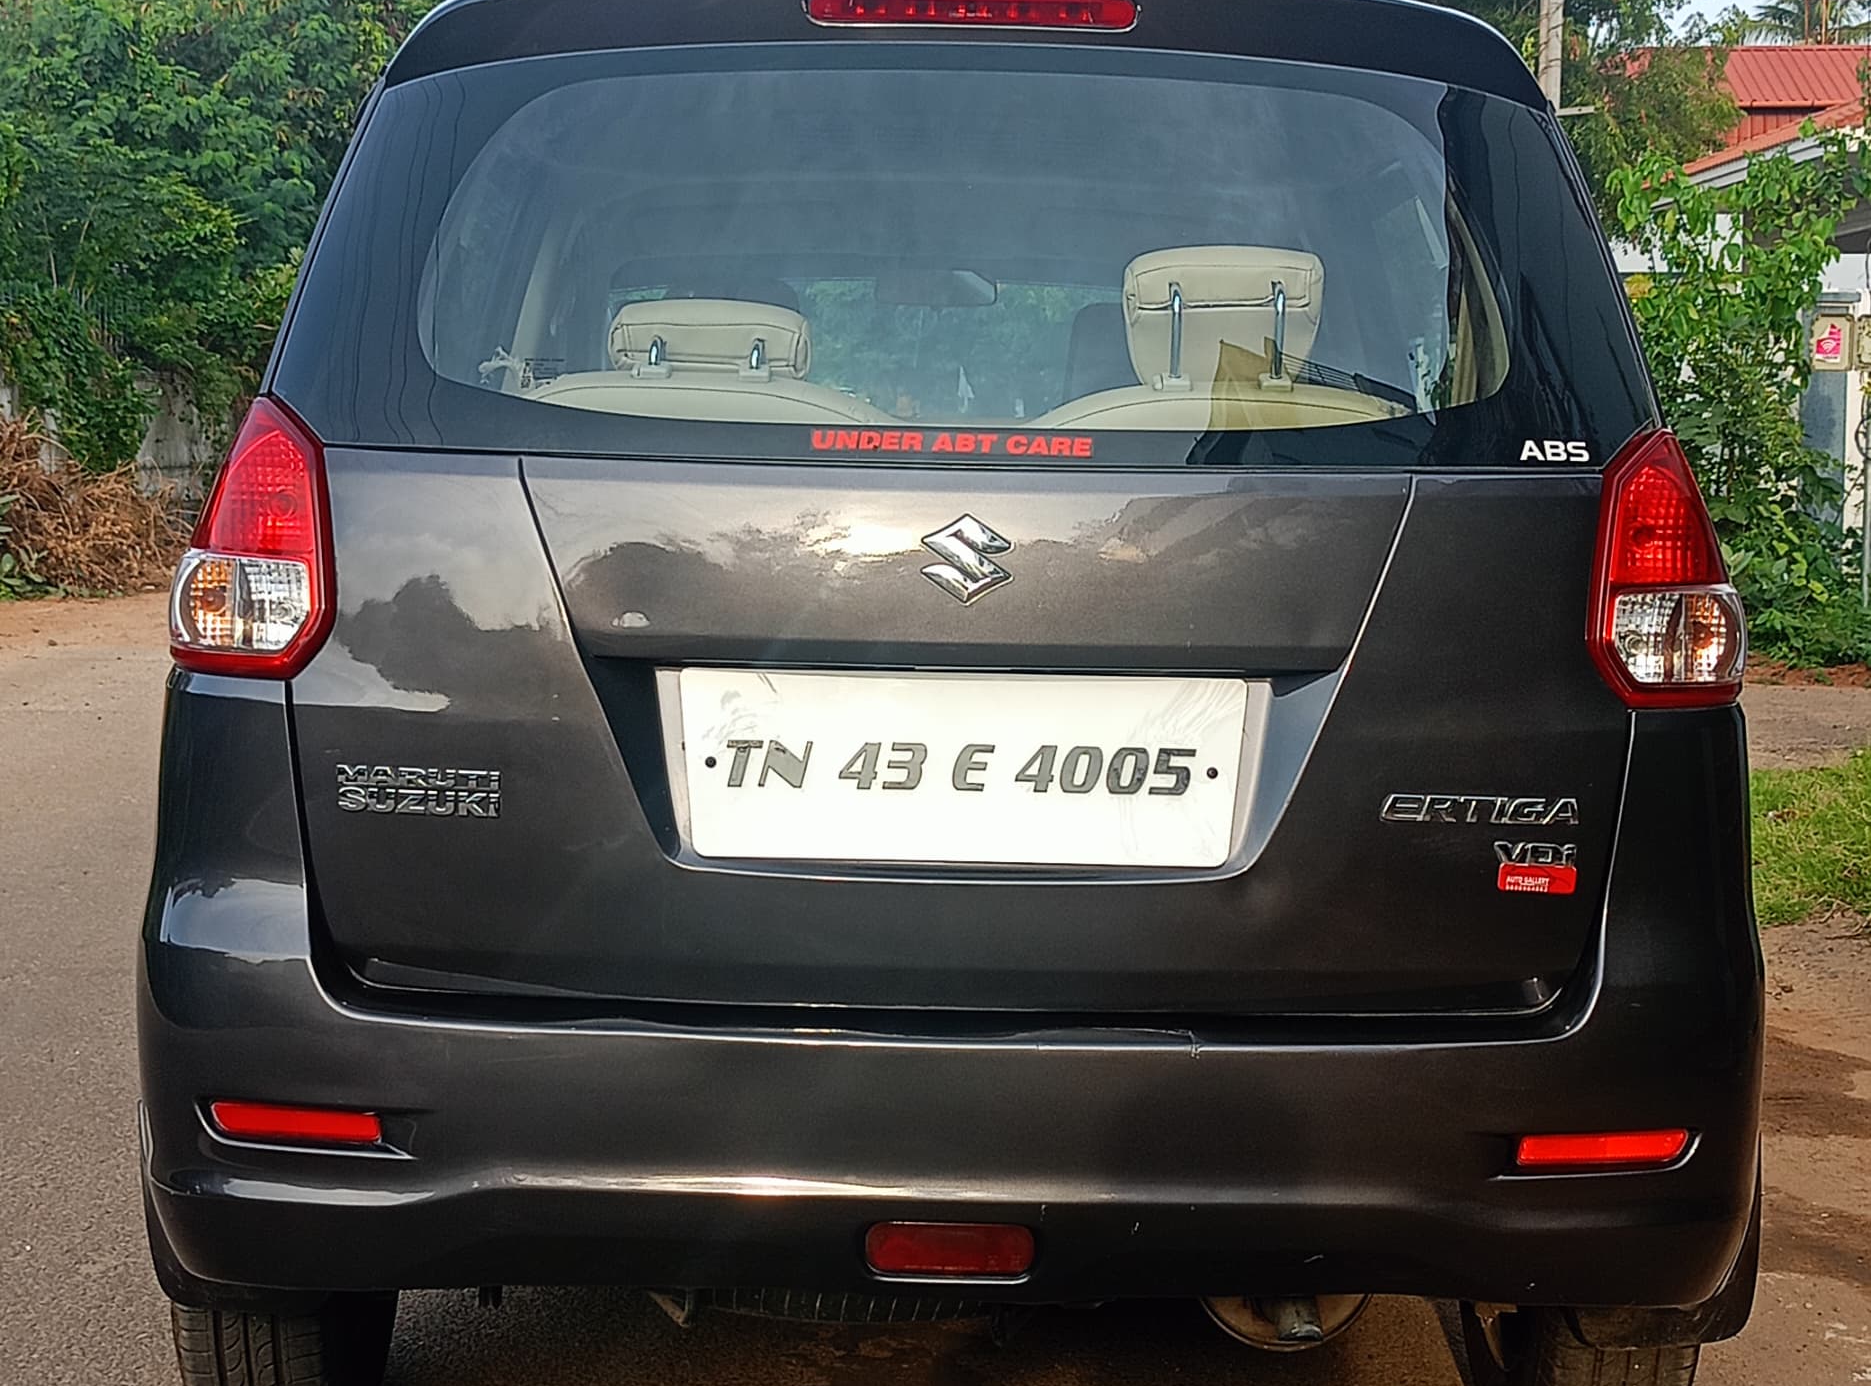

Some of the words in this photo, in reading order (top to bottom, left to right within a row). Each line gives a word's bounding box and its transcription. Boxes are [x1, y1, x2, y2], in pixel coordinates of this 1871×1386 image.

[811, 429, 924, 452] UNDER
[931, 432, 999, 455] ABT
[1006, 436, 1093, 457] CARE
[1519, 439, 1590, 462] ABS
[336, 764, 500, 790] MARUTI
[726, 739, 814, 789] TN
[838, 741, 928, 791] 43
[952, 743, 995, 792] E
[1014, 744, 1197, 796] 4005
[337, 786, 500, 817] SUZUKI
[1379, 793, 1579, 825] ERTIGA
